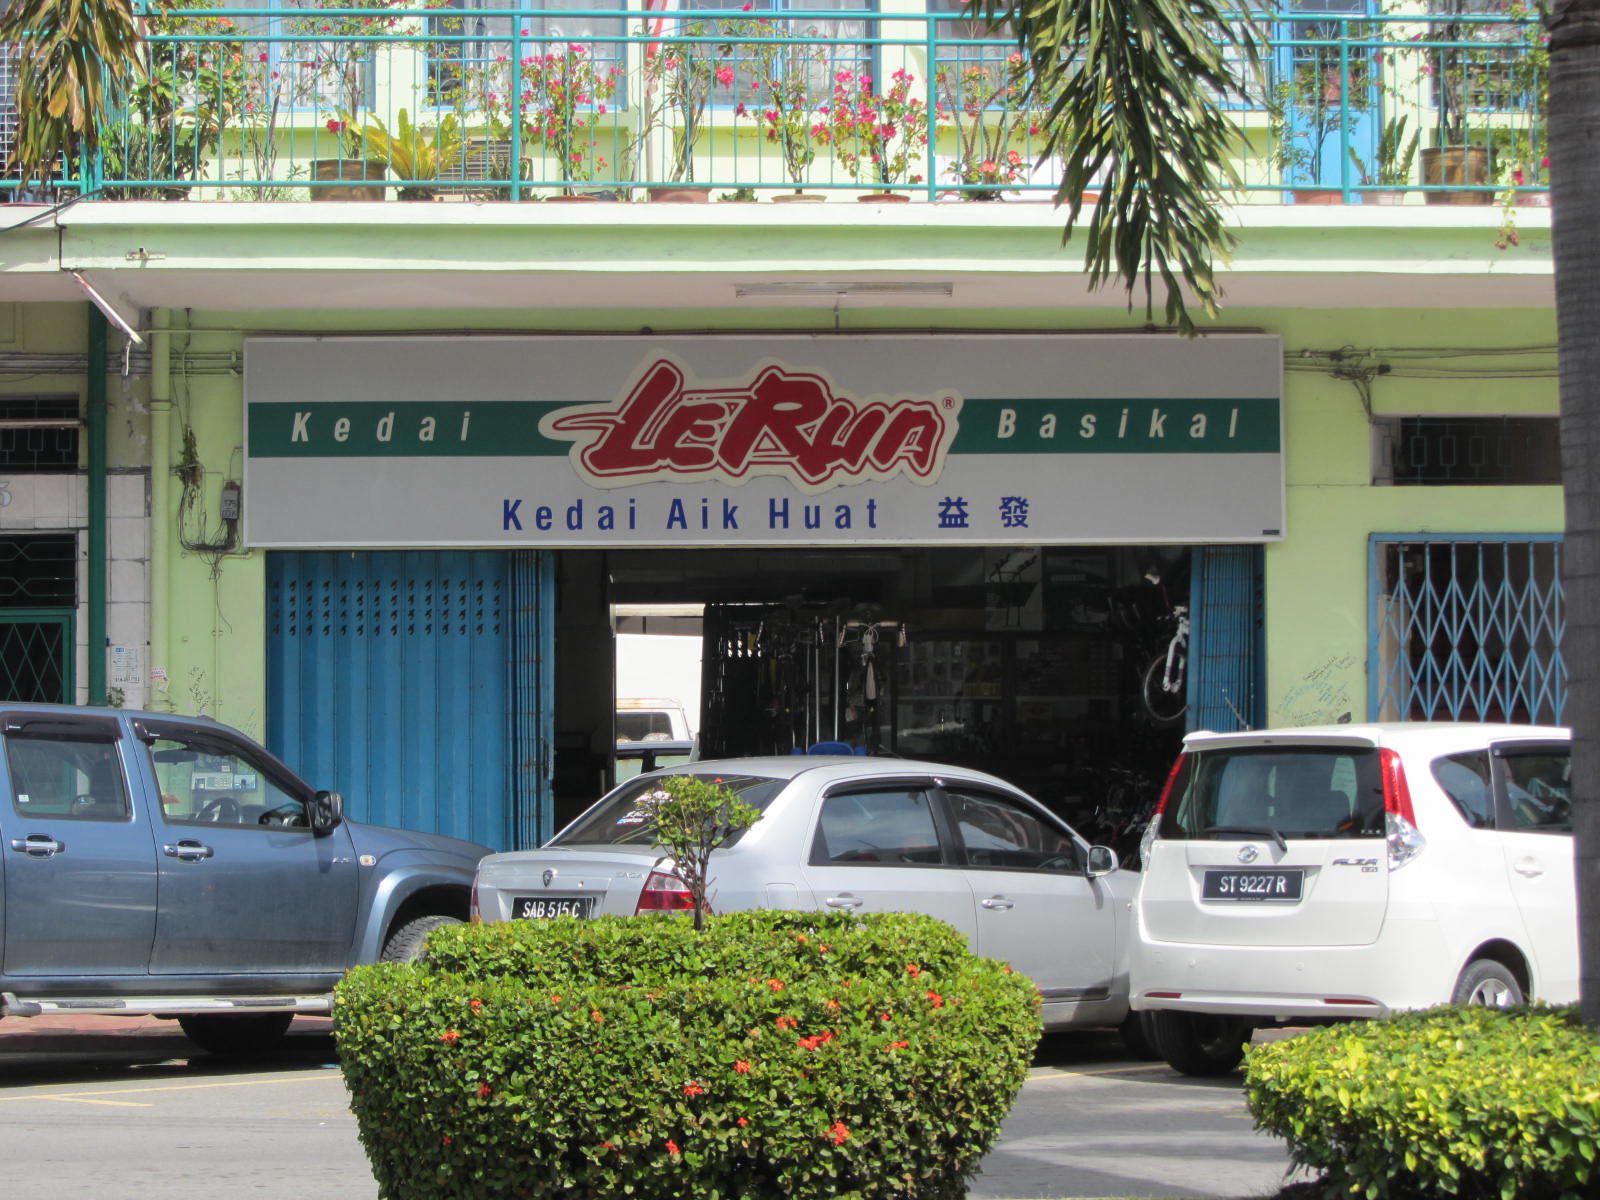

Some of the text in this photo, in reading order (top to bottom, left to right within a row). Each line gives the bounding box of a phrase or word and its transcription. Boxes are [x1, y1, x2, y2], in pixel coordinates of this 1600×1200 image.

[291, 411, 470, 442] Kedai
[997, 408, 1238, 439] Basikal
[502, 497, 877, 530] Kedai Aik Huat
[938, 496, 1029, 529] 益發
[1219, 875, 1286, 893] ST 9227 R
[522, 901, 581, 918] SAB 515 C
